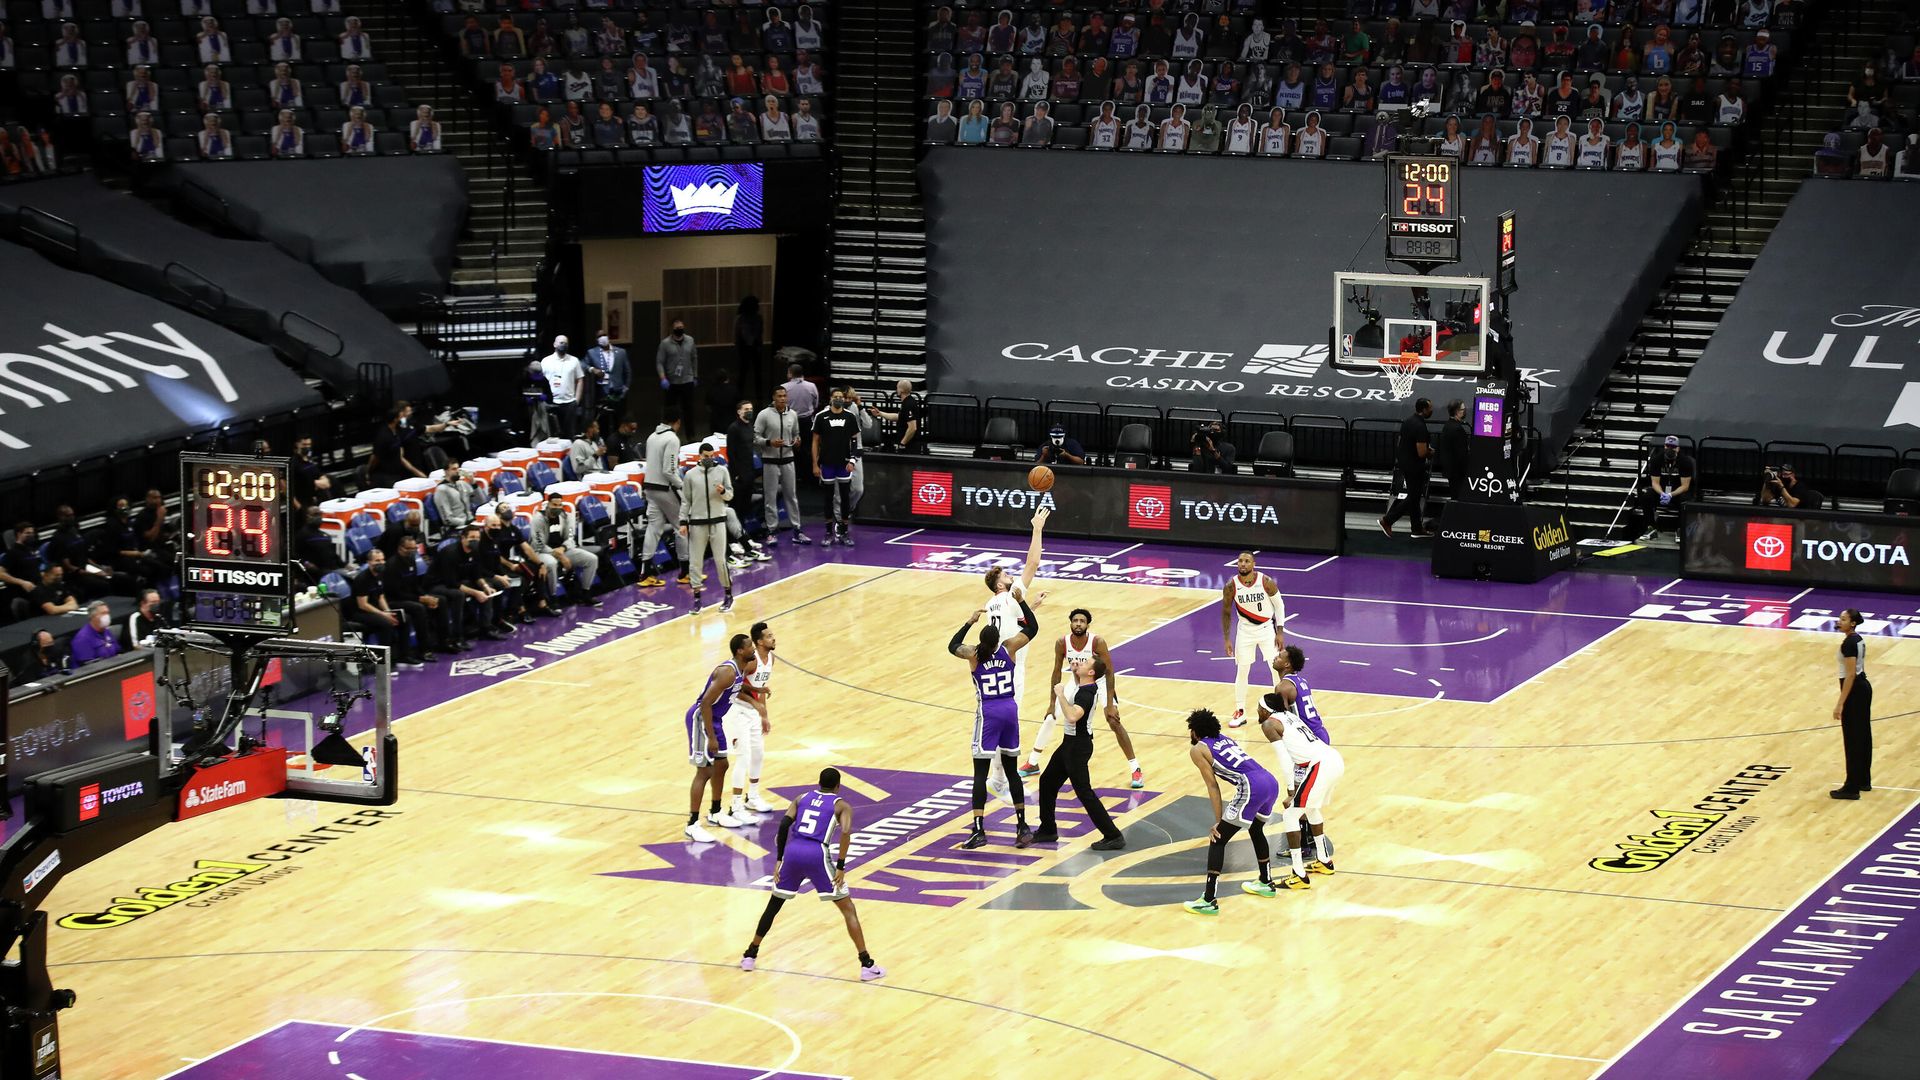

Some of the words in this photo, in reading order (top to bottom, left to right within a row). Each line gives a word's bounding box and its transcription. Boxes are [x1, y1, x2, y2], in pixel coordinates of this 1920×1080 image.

[1404, 163, 1449, 182] 12:00
[1403, 183, 1444, 215] 24
[1409, 223, 1454, 233] TISSOT
[1001, 342, 1235, 370] CACHE
[1105, 375, 1245, 393] CASINO
[1475, 386, 1506, 396] SPALDING
[1478, 402, 1500, 412] MEBO
[207, 470, 276, 502] 12:00
[1467, 477, 1502, 498] vsp
[961, 486, 1056, 511] TOYOTA
[1180, 500, 1279, 525] TOYOTA
[205, 502, 270, 556] 24
[1441, 530, 1477, 541] CACHE
[1491, 534, 1525, 545] CREEK
[1460, 541, 1481, 549] CASINO
[1801, 539, 1910, 566] TOYOTA
[906, 562, 988, 574] KAISER
[925, 551, 1200, 578] thrive
[214, 569, 283, 587] TISSOT
[1237, 592, 1265, 604] BLAZERS
[1257, 602, 1263, 612] 0
[983, 660, 1006, 670] HOLMES
[981, 671, 1013, 695] 22
[101, 781, 144, 805] TOYOTA
[1693, 764, 1792, 812] CENTER
[798, 809, 821, 834] 5
[246, 809, 404, 862] CENTER
[1692, 833, 1736, 854] Credit
[1725, 815, 1760, 834] Union
[186, 879, 252, 908] Credit
[247, 864, 304, 886] Union
[1682, 883, 1920, 1040] SACRAMENTO
